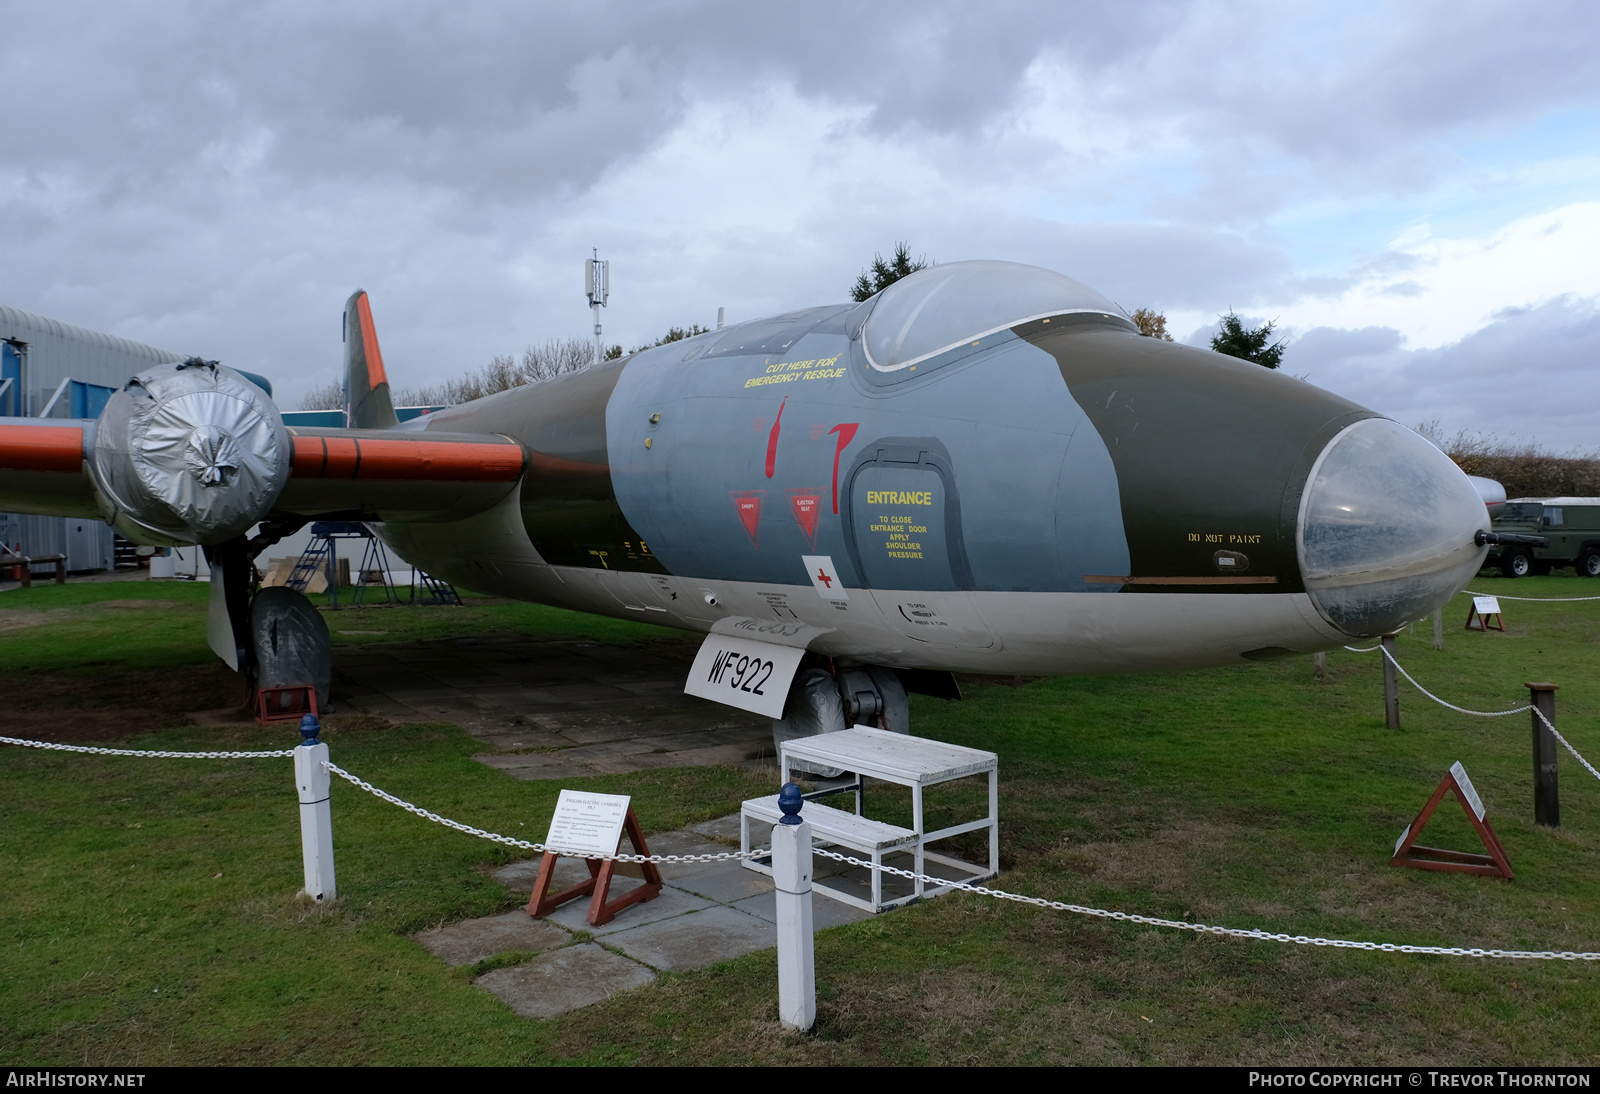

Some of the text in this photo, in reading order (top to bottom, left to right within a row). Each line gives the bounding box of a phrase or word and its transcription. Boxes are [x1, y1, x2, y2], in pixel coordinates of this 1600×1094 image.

[765, 357, 838, 374] CUT HERE FOR
[743, 367, 847, 389] EMERGENCY RESCUE
[867, 491, 932, 505] ENTRANCE
[879, 515, 889, 523] TO
[870, 524, 927, 533] ENTRANCE DOOR
[889, 533, 910, 541] APPLY
[1188, 533, 1261, 544] DO NOT PAINT
[885, 542, 921, 550] SHOULDER
[888, 551, 923, 559] PRESSURE
[707, 650, 774, 696] WF922
